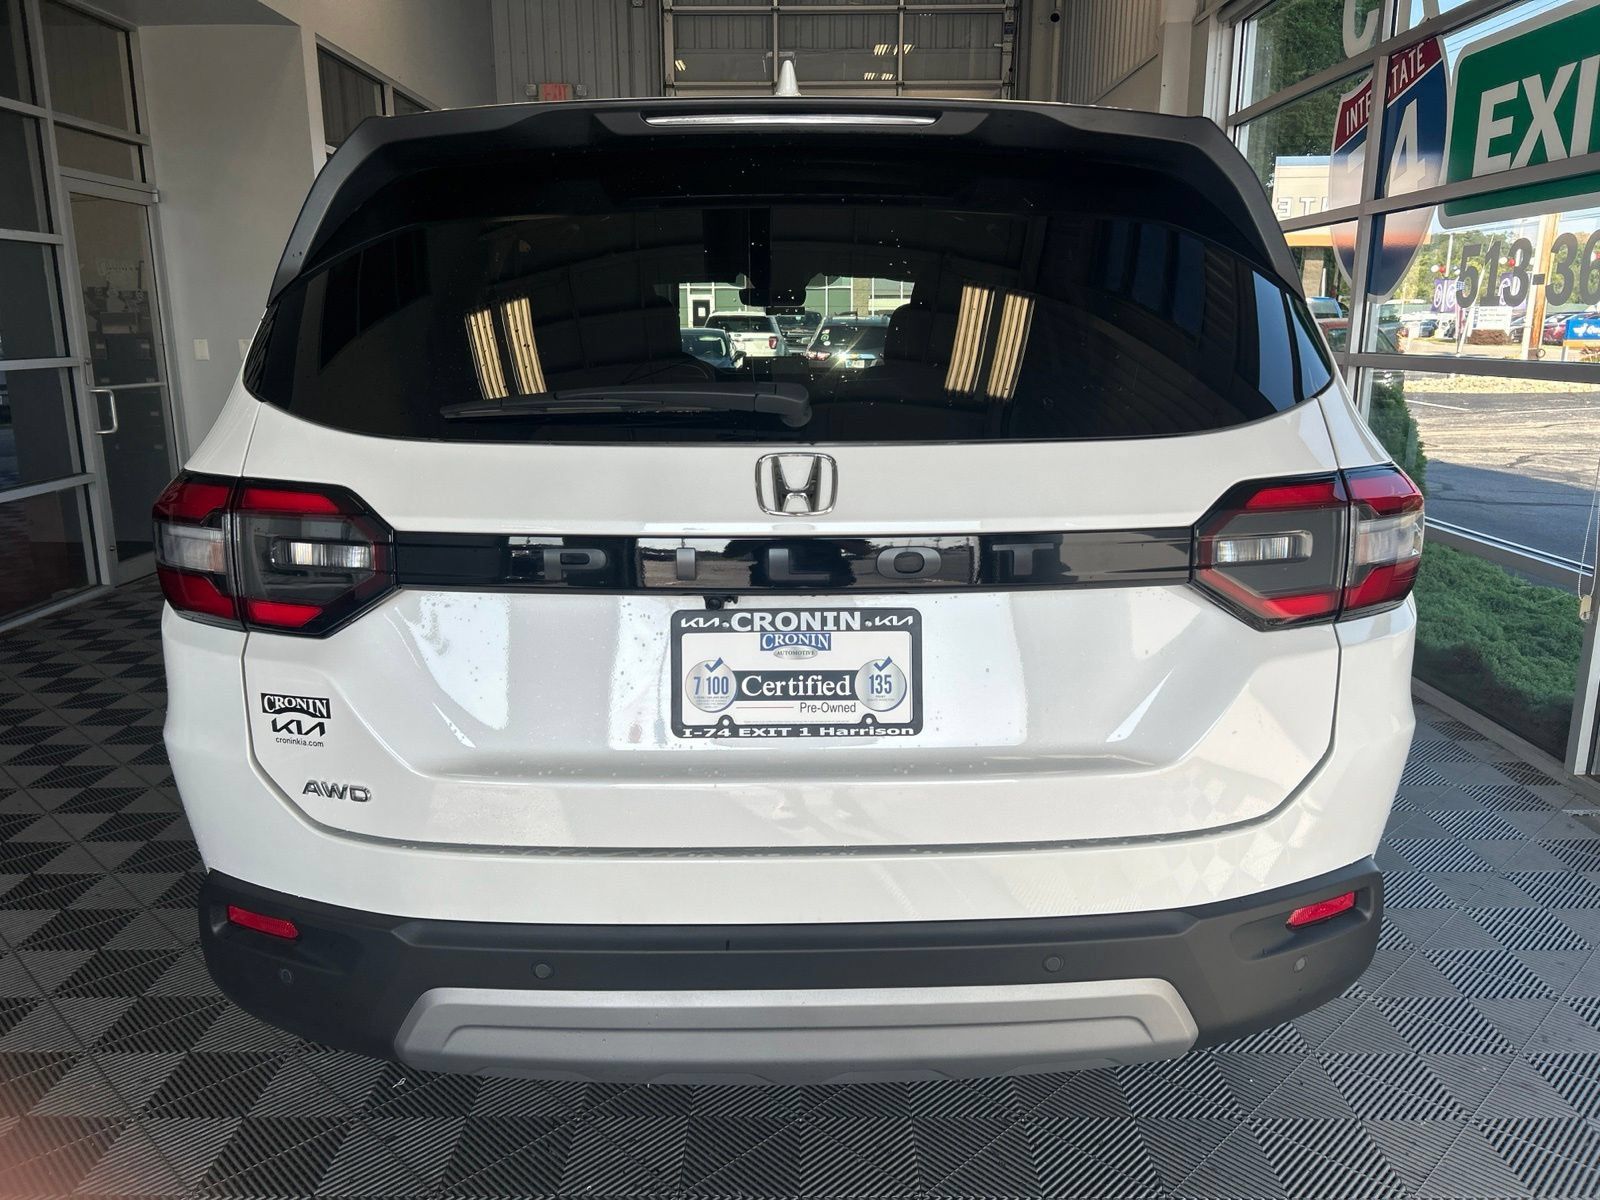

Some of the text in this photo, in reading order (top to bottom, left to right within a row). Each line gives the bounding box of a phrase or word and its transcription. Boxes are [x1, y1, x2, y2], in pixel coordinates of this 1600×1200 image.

[1346, 43, 1425, 136] INTETATE
[543, 542, 1054, 582] PILOT
[731, 612, 860, 632] CRONIN
[762, 633, 830, 650] CRONIN
[741, 675, 852, 696] Certified
[869, 674, 892, 694] 135
[262, 694, 328, 718] CRONIN
[800, 702, 857, 713] Pre-Owned
[682, 726, 915, 738] I-74 EXIT 1 Harrison
[275, 737, 324, 748] croninkia.com
[302, 780, 371, 802] AWD
